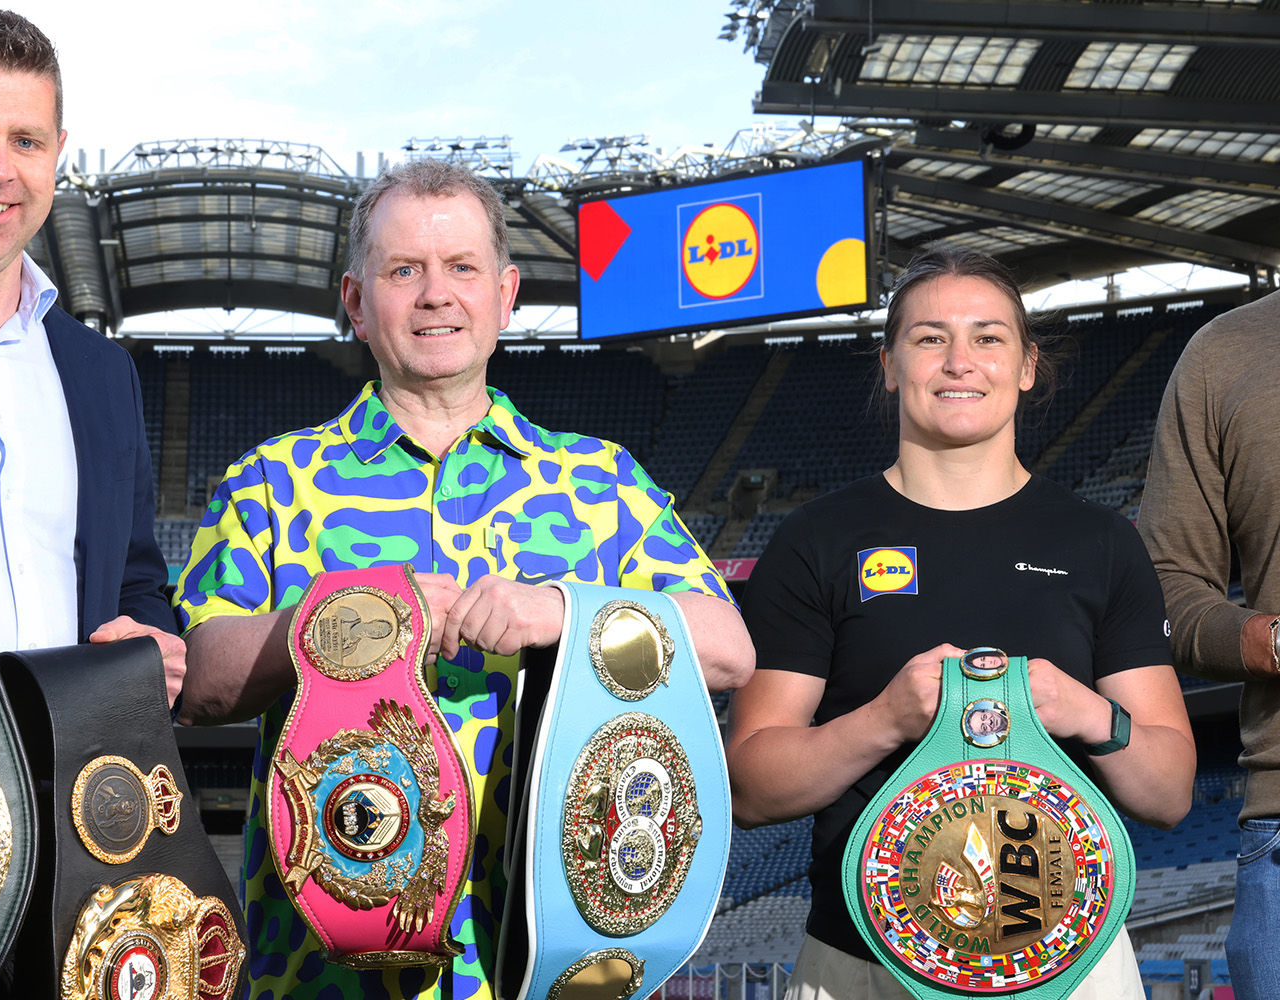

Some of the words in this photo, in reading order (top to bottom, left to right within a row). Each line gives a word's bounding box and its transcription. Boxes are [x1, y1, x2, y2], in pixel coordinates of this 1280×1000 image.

[1015, 562, 1069, 576] Champion
[381, 778, 400, 796] WORLD
[398, 796, 409, 822] FEMALE
[617, 765, 637, 818] Champion
[342, 802, 359, 836] WBO
[666, 817, 677, 842] IBF
[640, 821, 663, 891] International
[904, 796, 986, 898] CHAMPION
[1051, 834, 1064, 909] FEMALE
[996, 810, 1043, 938] WBC
[914, 901, 992, 954] WORLD
